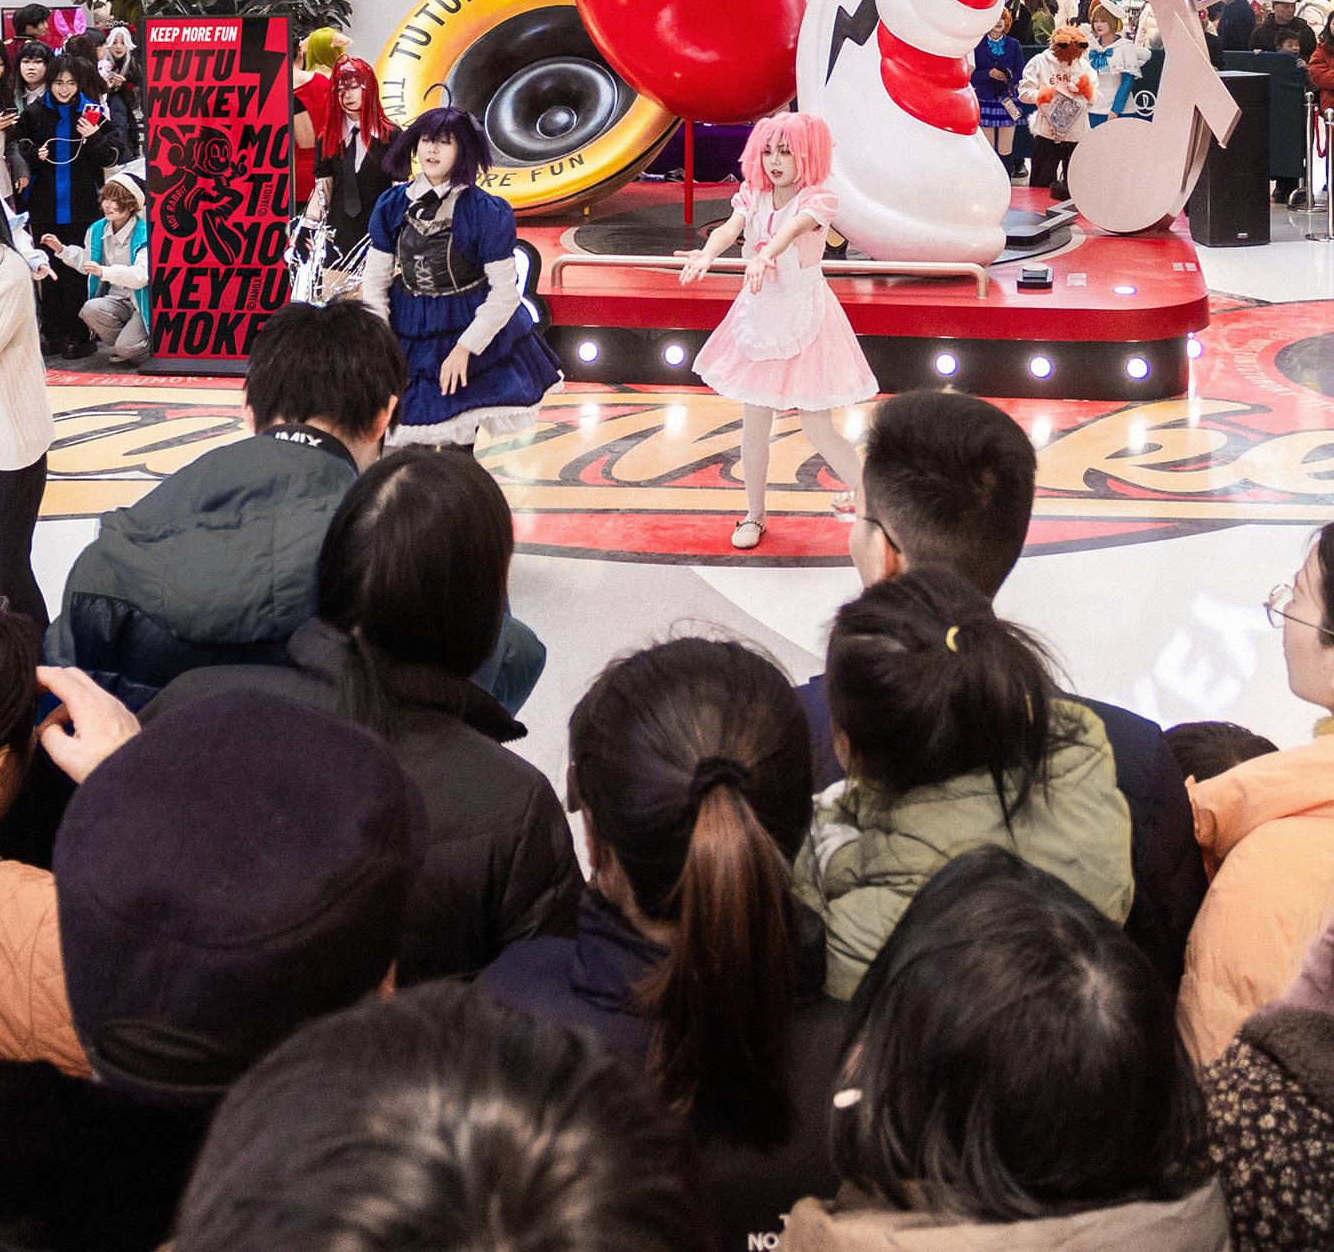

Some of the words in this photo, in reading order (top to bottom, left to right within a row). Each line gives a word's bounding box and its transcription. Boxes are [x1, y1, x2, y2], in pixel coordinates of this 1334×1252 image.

[150, 27, 179, 42] KEEP
[181, 27, 212, 42] MORE
[214, 26, 238, 42] FUN
[151, 49, 237, 82] TUTU
[148, 86, 258, 118] MOKEY
[530, 153, 586, 183] FUN
[170, 185, 188, 211] RABBIT
[170, 205, 179, 230] NOT
